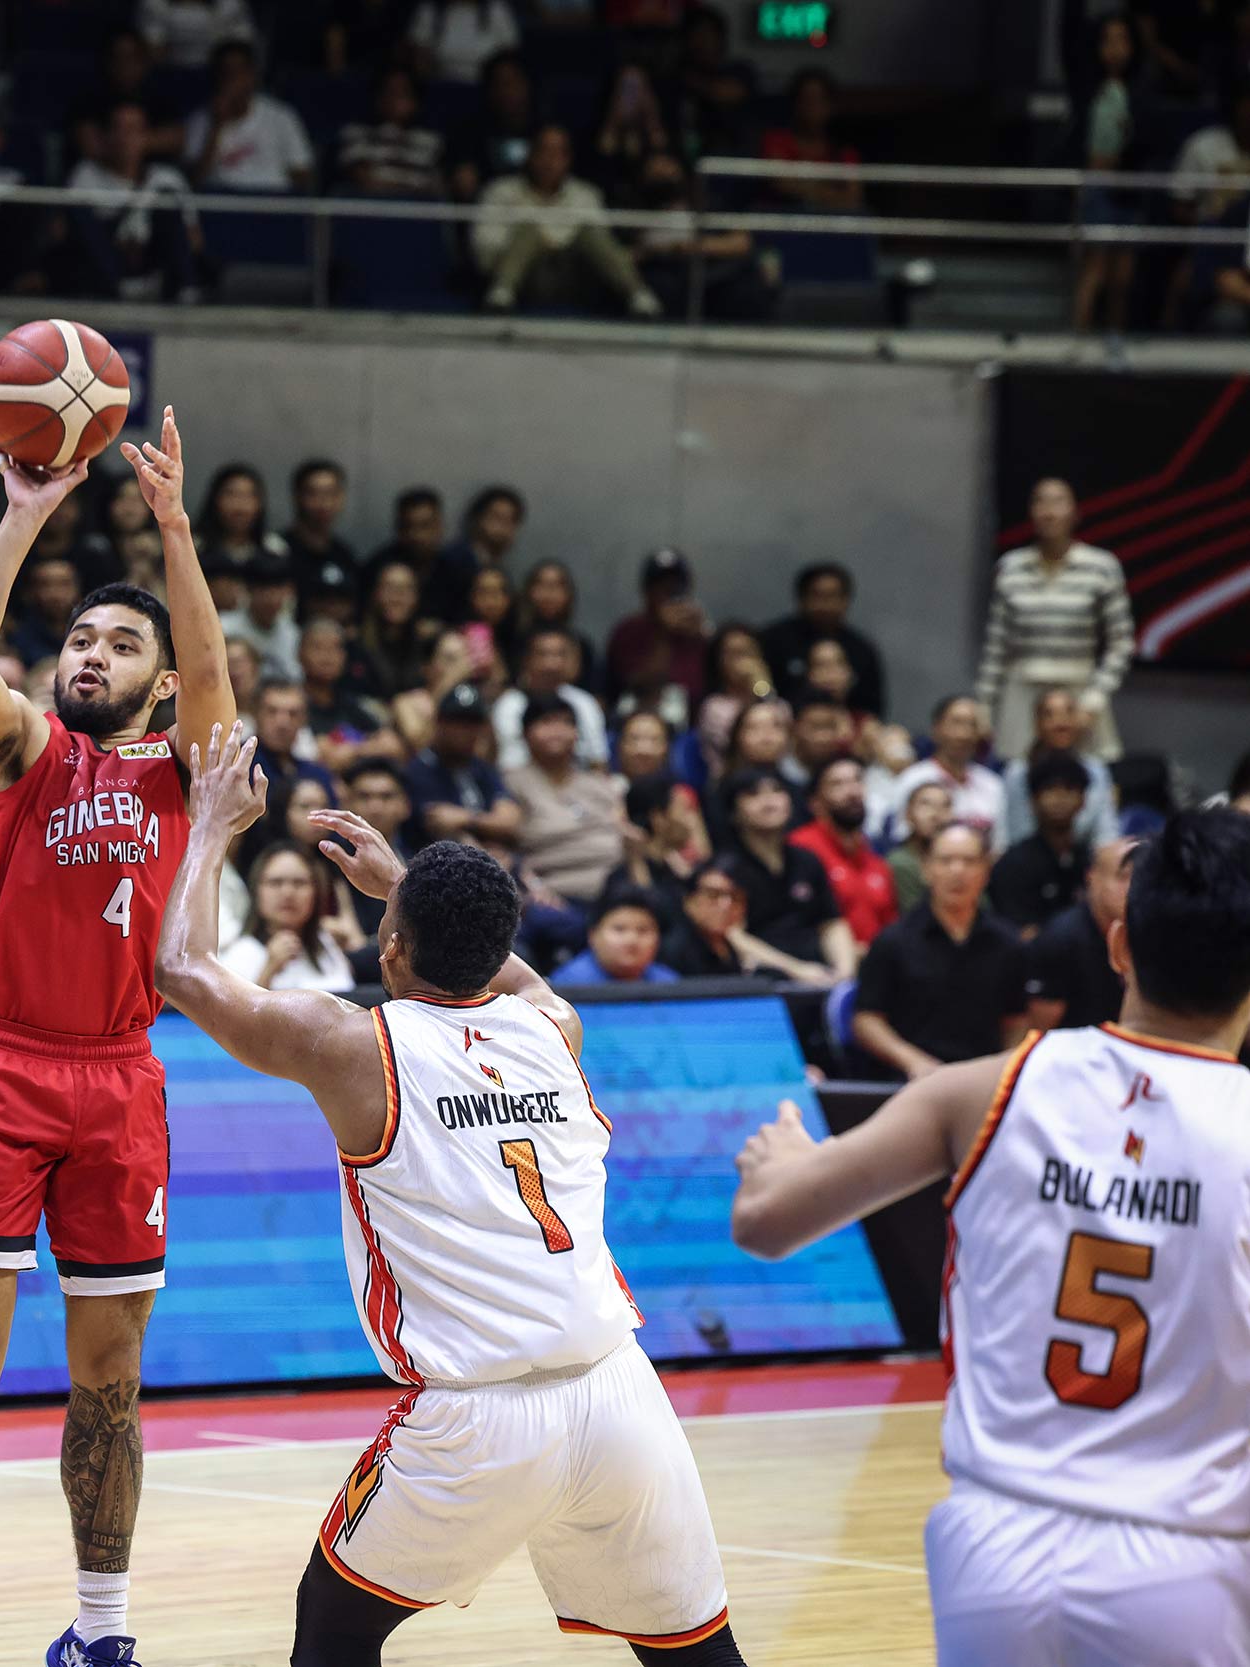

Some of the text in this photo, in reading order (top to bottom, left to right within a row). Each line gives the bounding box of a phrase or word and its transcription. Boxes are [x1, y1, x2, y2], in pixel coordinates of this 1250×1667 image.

[44, 791, 160, 859] GINEBRA
[56, 842, 100, 866] SAN
[101, 876, 135, 939] 4
[436, 1091, 568, 1130] ONWUBERE
[145, 1185, 165, 1237] 4
[497, 1137, 575, 1255] 1
[1040, 1158, 1200, 1226] BULANADI
[1044, 1230, 1155, 1412] 5
